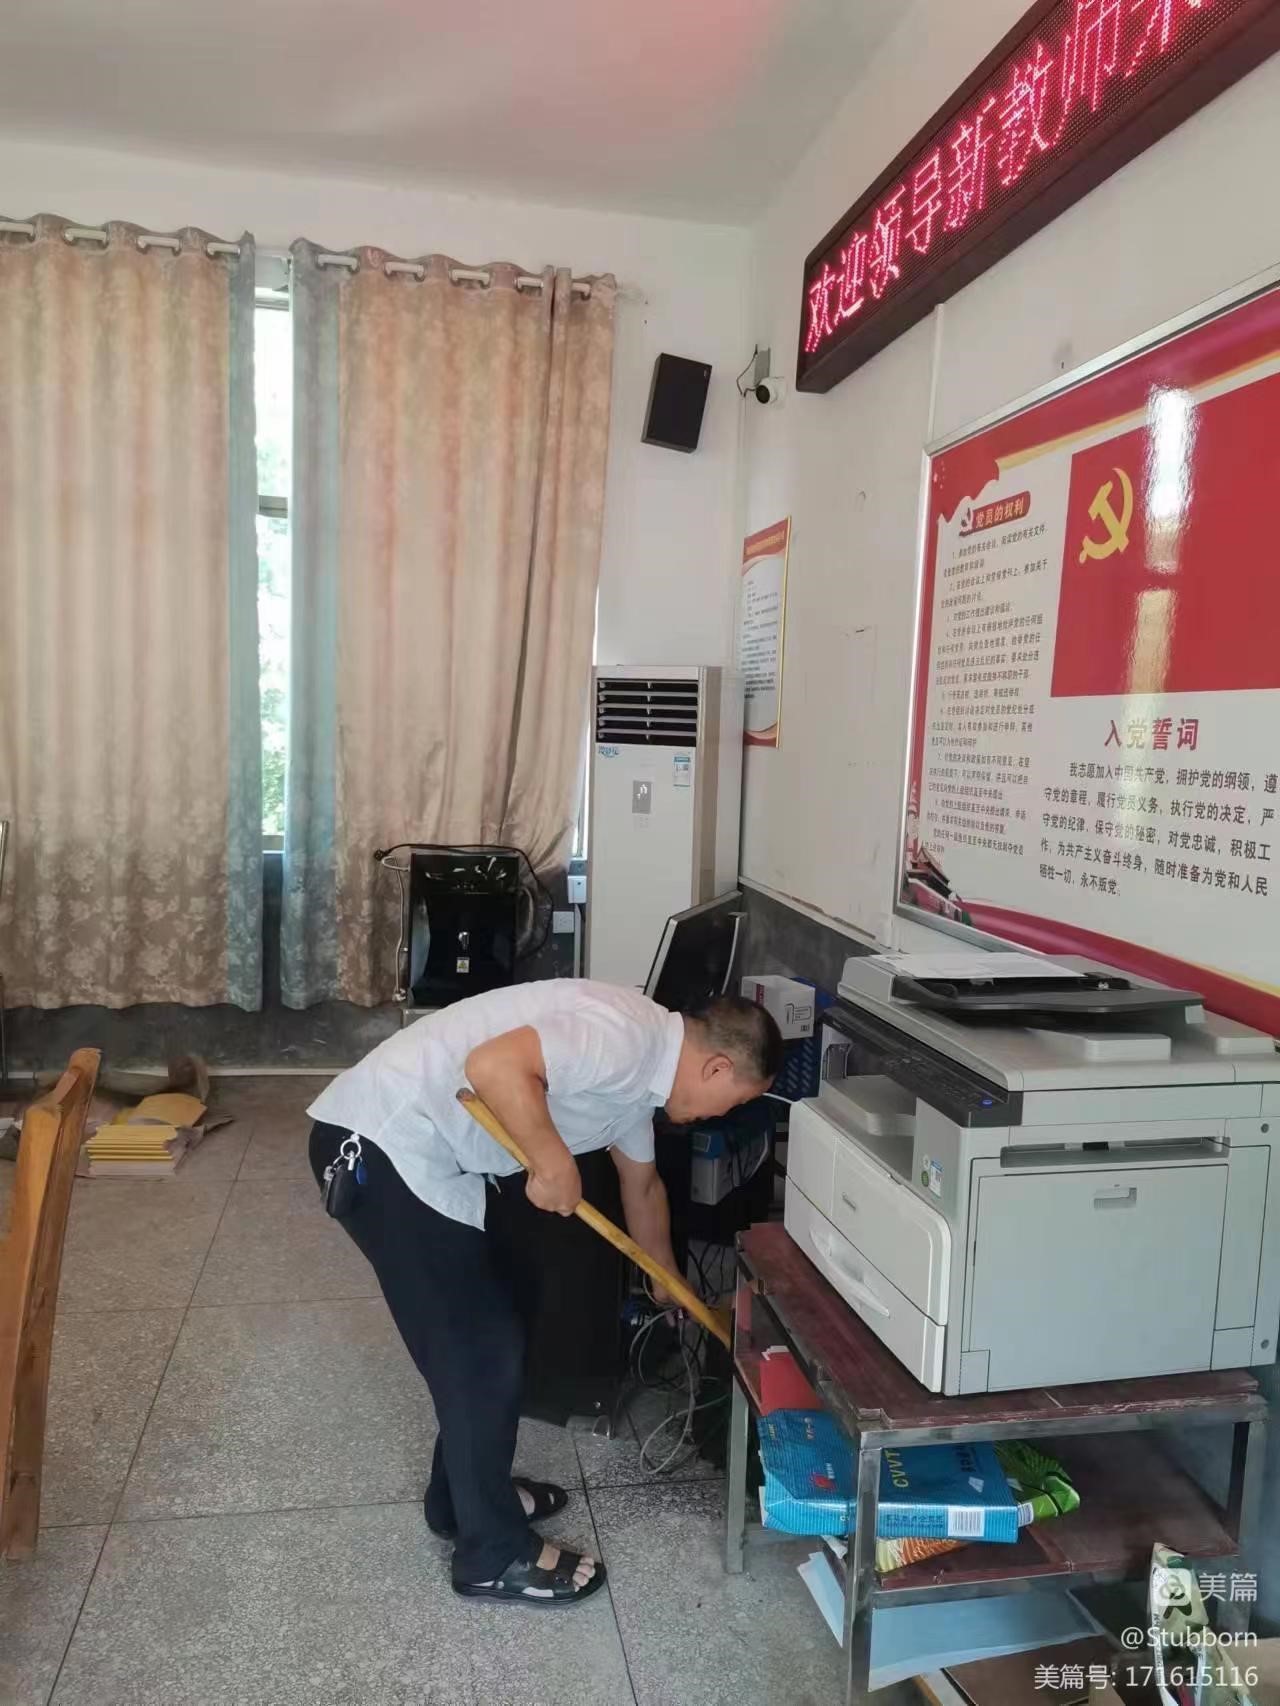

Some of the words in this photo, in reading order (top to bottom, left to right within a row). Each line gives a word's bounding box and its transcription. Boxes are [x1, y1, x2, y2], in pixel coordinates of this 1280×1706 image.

[975, 499, 1024, 527] 党员的权利
[1104, 717, 1199, 750] 入党誓词
[881, 1449, 910, 1488] CVVT
